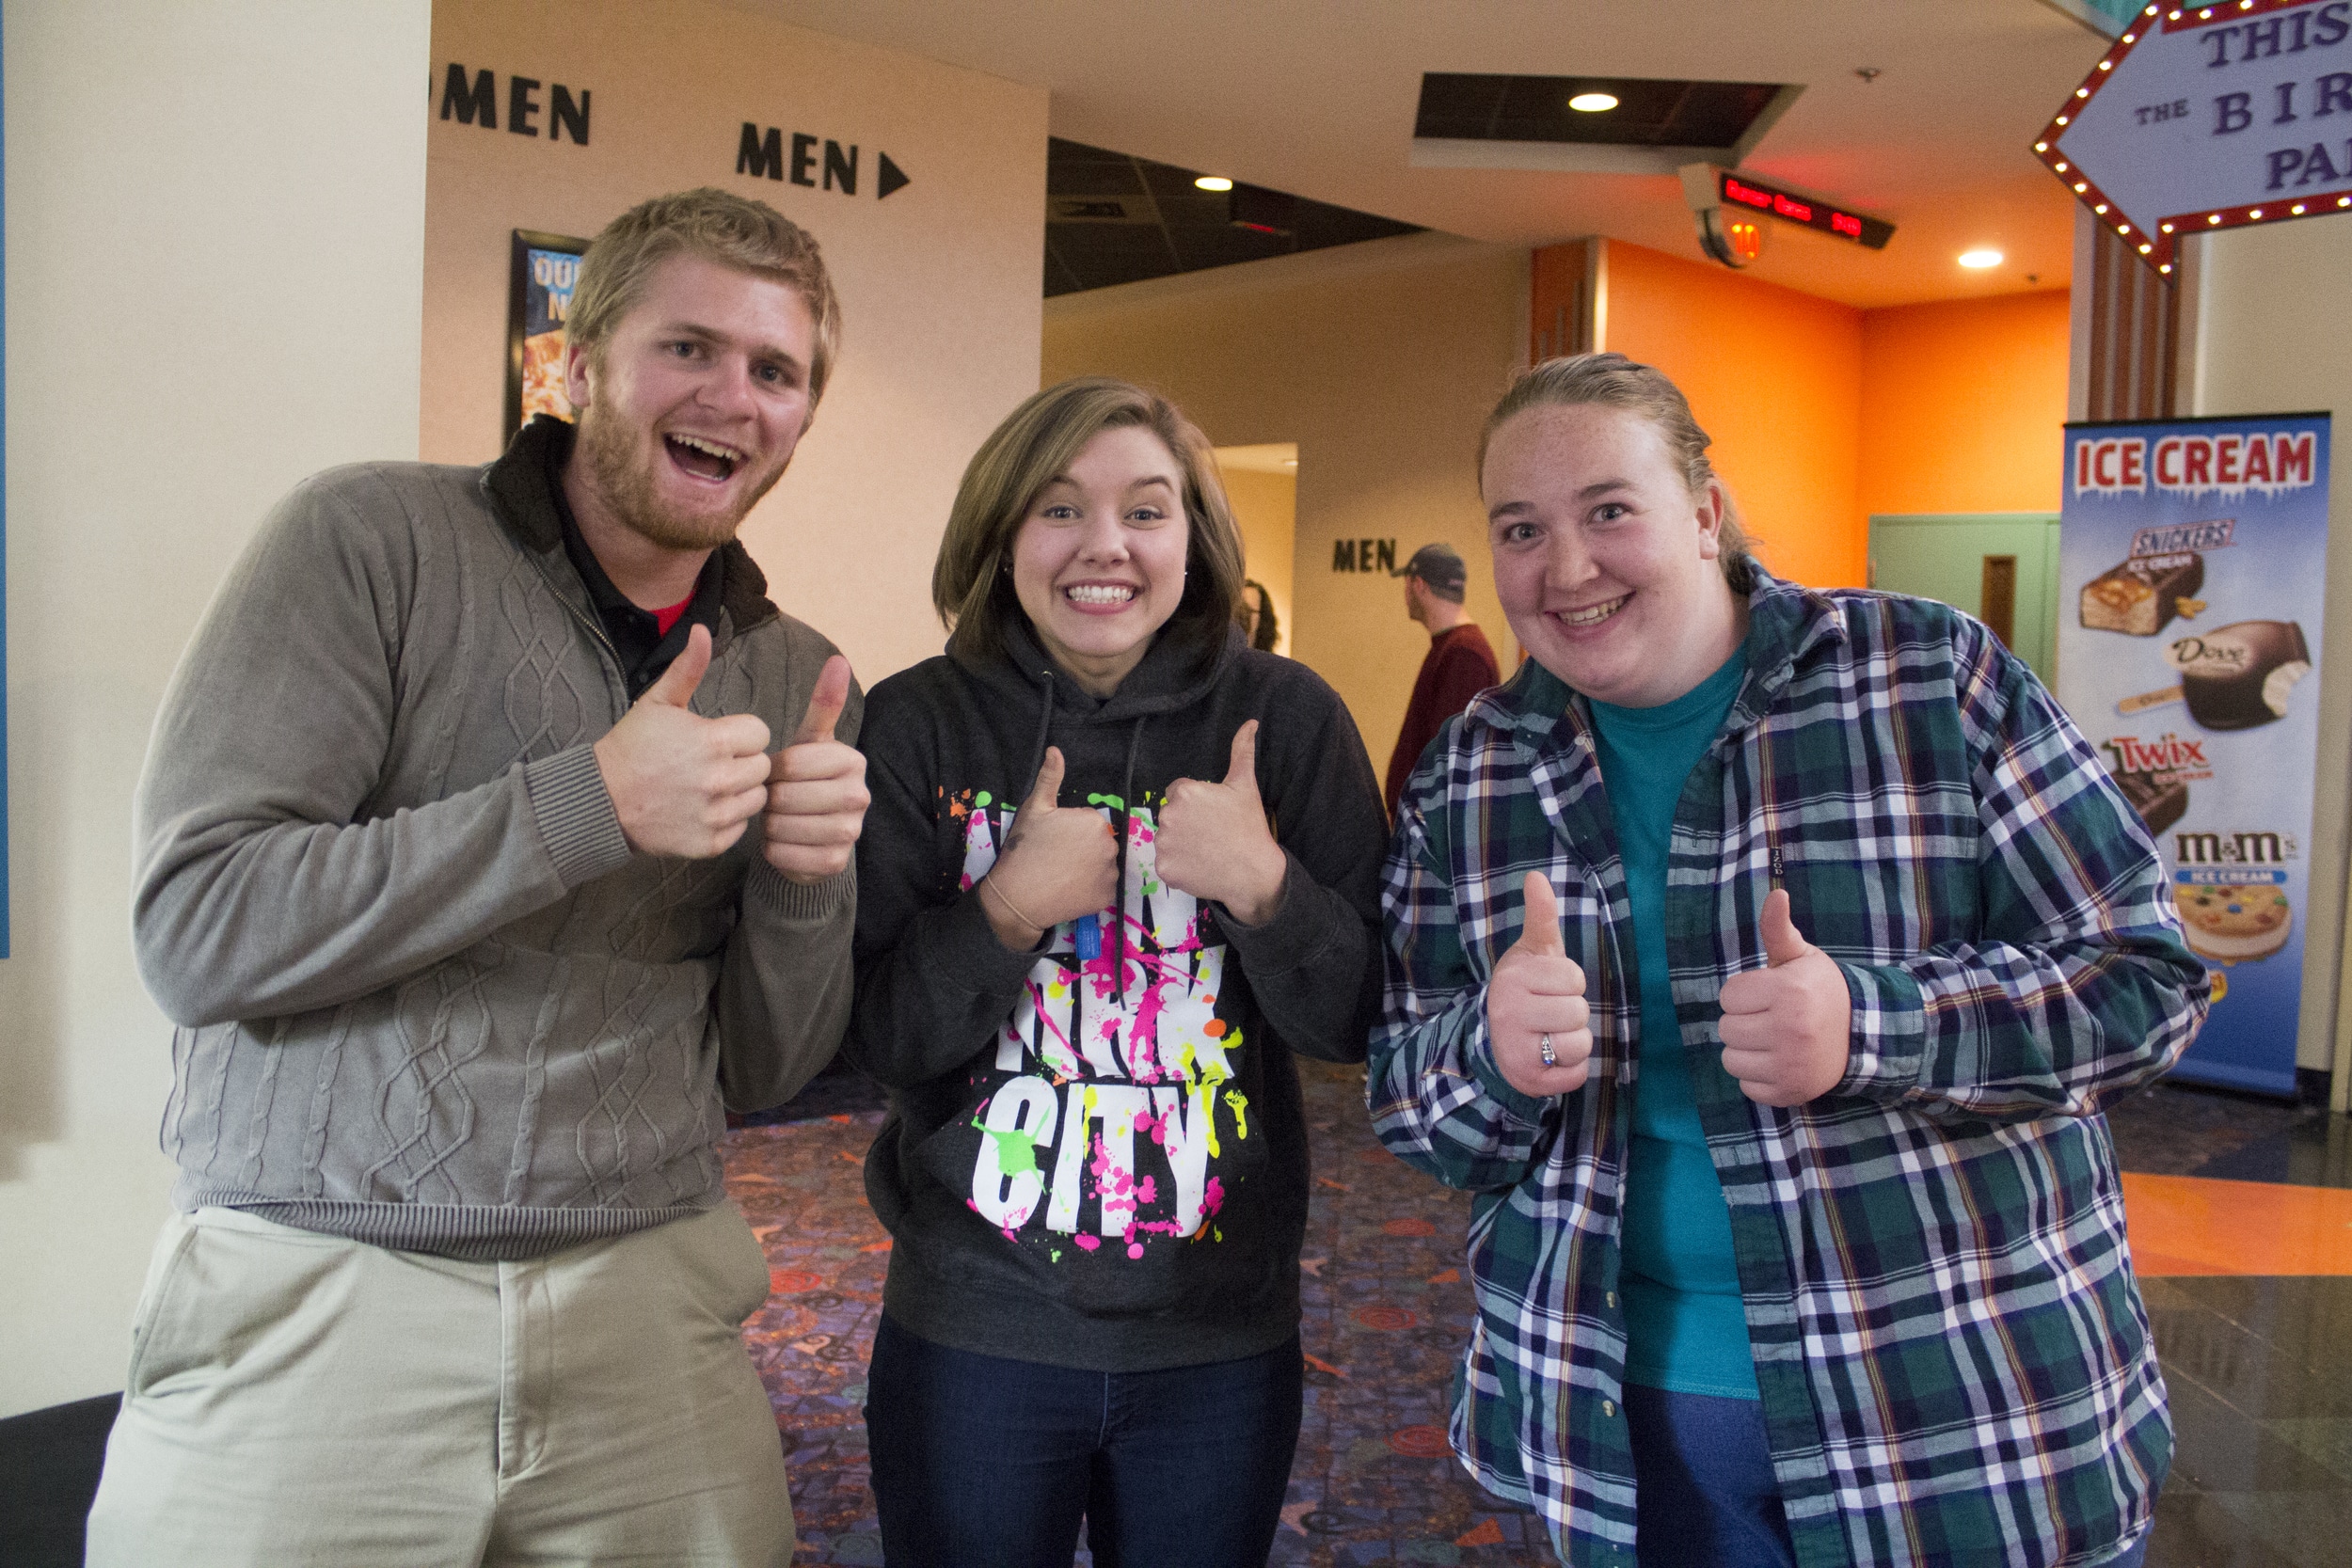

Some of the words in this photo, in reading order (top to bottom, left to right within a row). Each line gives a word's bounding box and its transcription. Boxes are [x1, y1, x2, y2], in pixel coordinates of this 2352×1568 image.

[2200, 2, 2350, 69] THIS
[429, 62, 591, 146] MEN
[2135, 98, 2189, 126] THE
[736, 121, 858, 196] MEN
[2265, 139, 2352, 191] PA
[2077, 441, 2144, 487] ICE
[2154, 436, 2313, 487] CREAM
[1331, 538, 1396, 573] MEN
[2136, 522, 2230, 555] SNICKERS
[2172, 637, 2245, 663] Dove
[2110, 731, 2208, 770] Twix
[973, 1075, 1217, 1238] CITY
